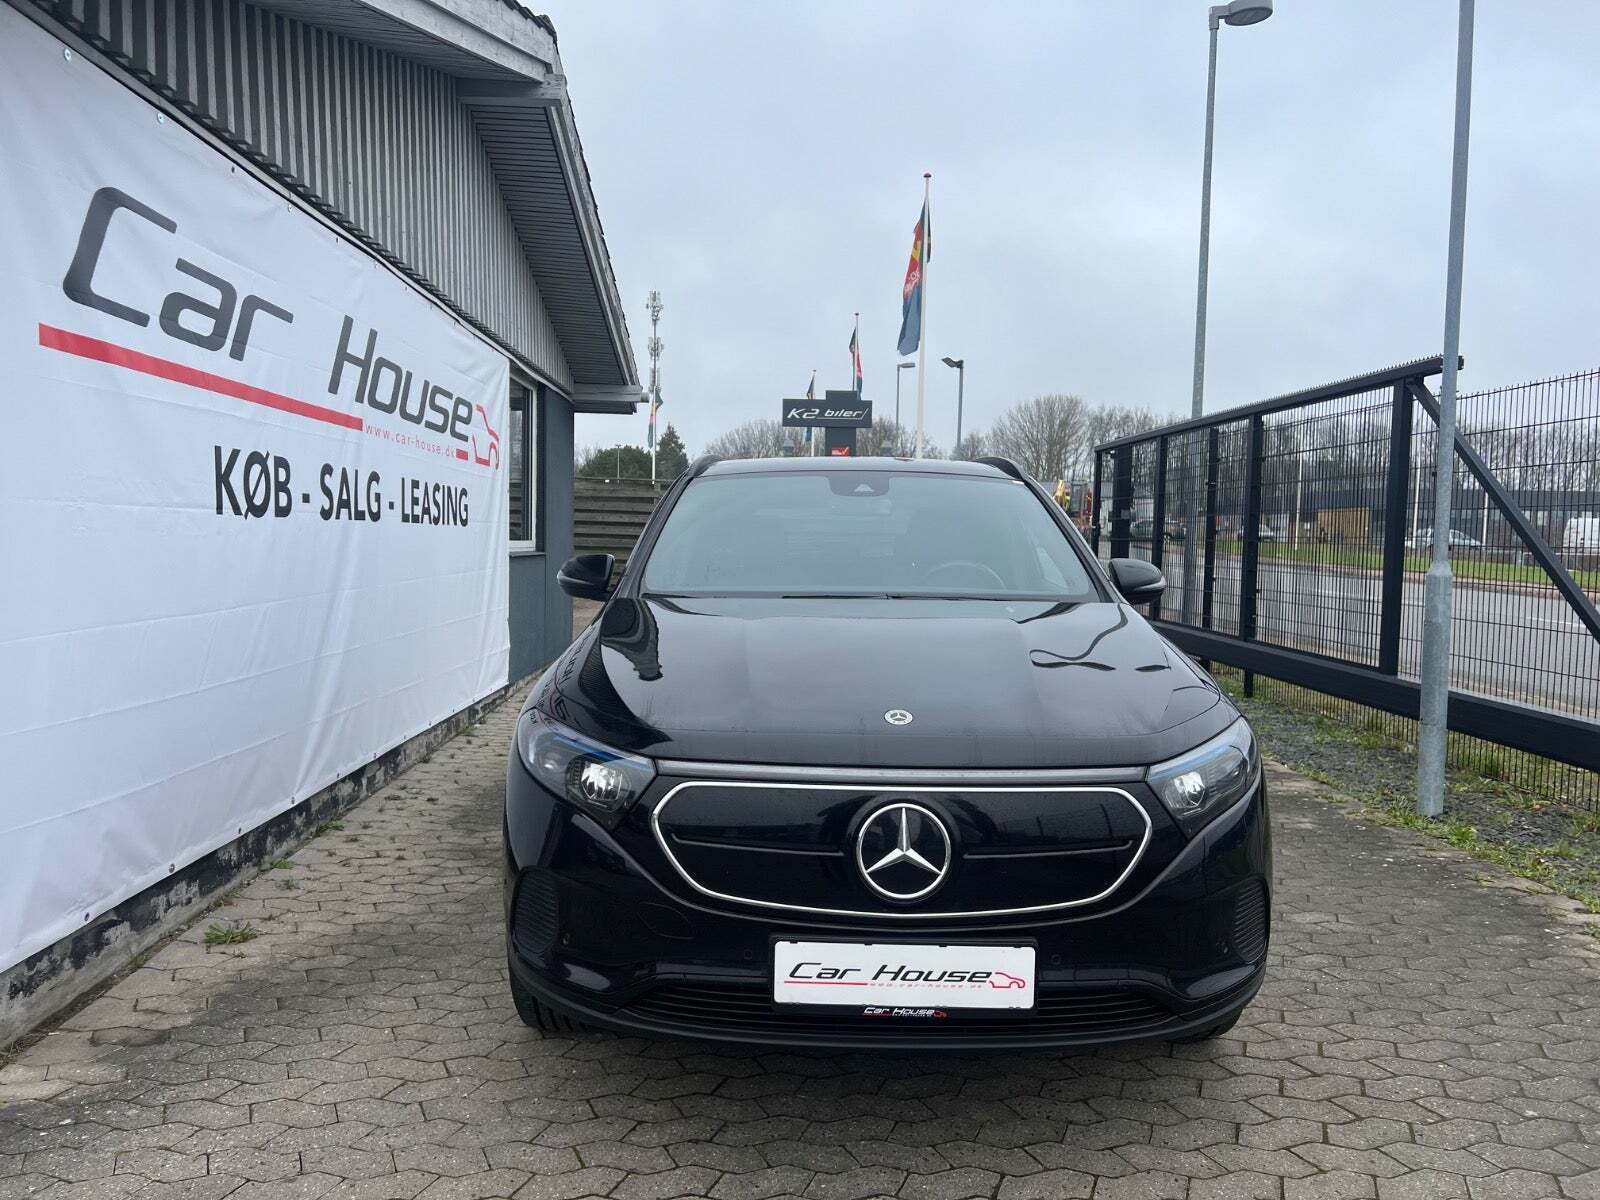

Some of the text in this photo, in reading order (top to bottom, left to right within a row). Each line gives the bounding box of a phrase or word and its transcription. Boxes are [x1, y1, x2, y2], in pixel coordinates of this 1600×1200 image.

[62, 186, 473, 442] Car House
[787, 408, 862, 419] K2 biler
[365, 423, 455, 457] www.car-house.dk
[214, 445, 292, 520] KØB
[319, 463, 381, 522] SALG
[401, 477, 469, 527] LEASING
[788, 962, 993, 983] Car House
[864, 1006, 890, 1015] Car
[892, 1007, 935, 1016] House
